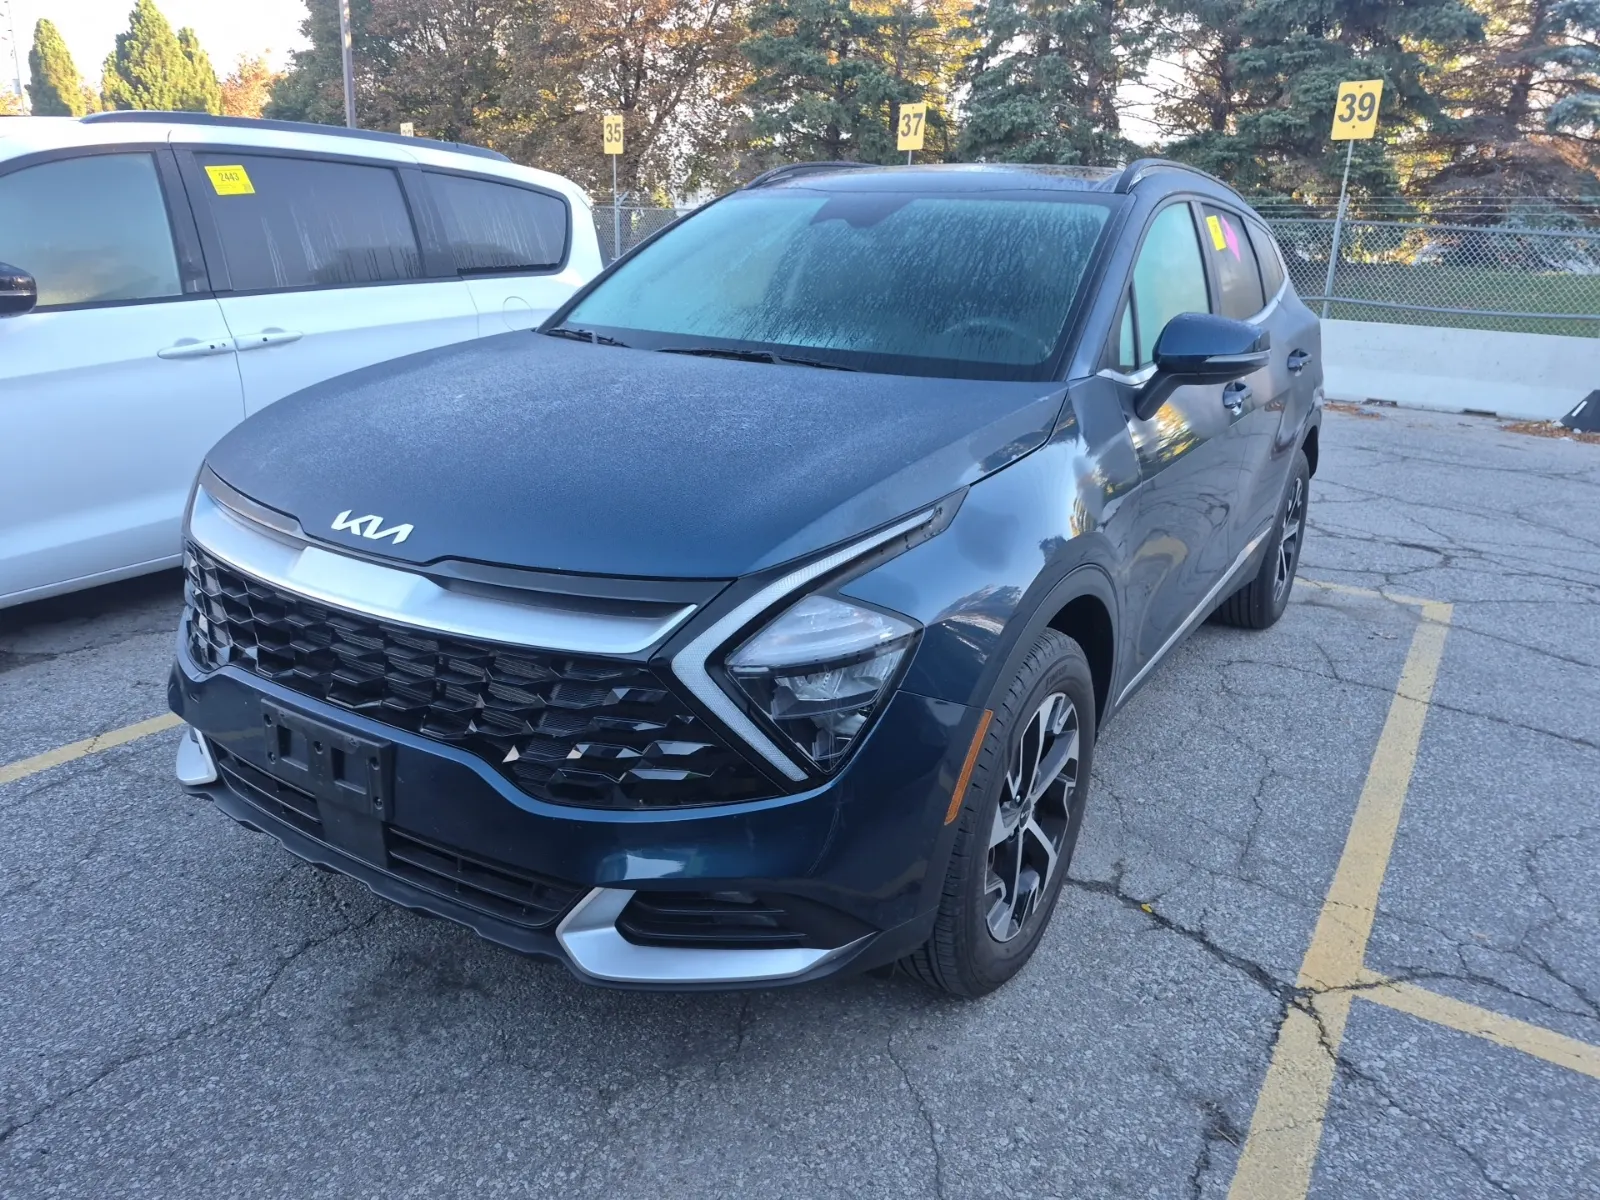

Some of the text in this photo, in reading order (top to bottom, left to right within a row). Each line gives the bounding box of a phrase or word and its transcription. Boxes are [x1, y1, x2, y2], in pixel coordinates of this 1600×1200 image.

[1338, 92, 1376, 122] 39
[606, 123, 621, 142] 35
[900, 113, 923, 137] 37
[218, 172, 240, 182] 2443
[331, 509, 414, 545] KIA
